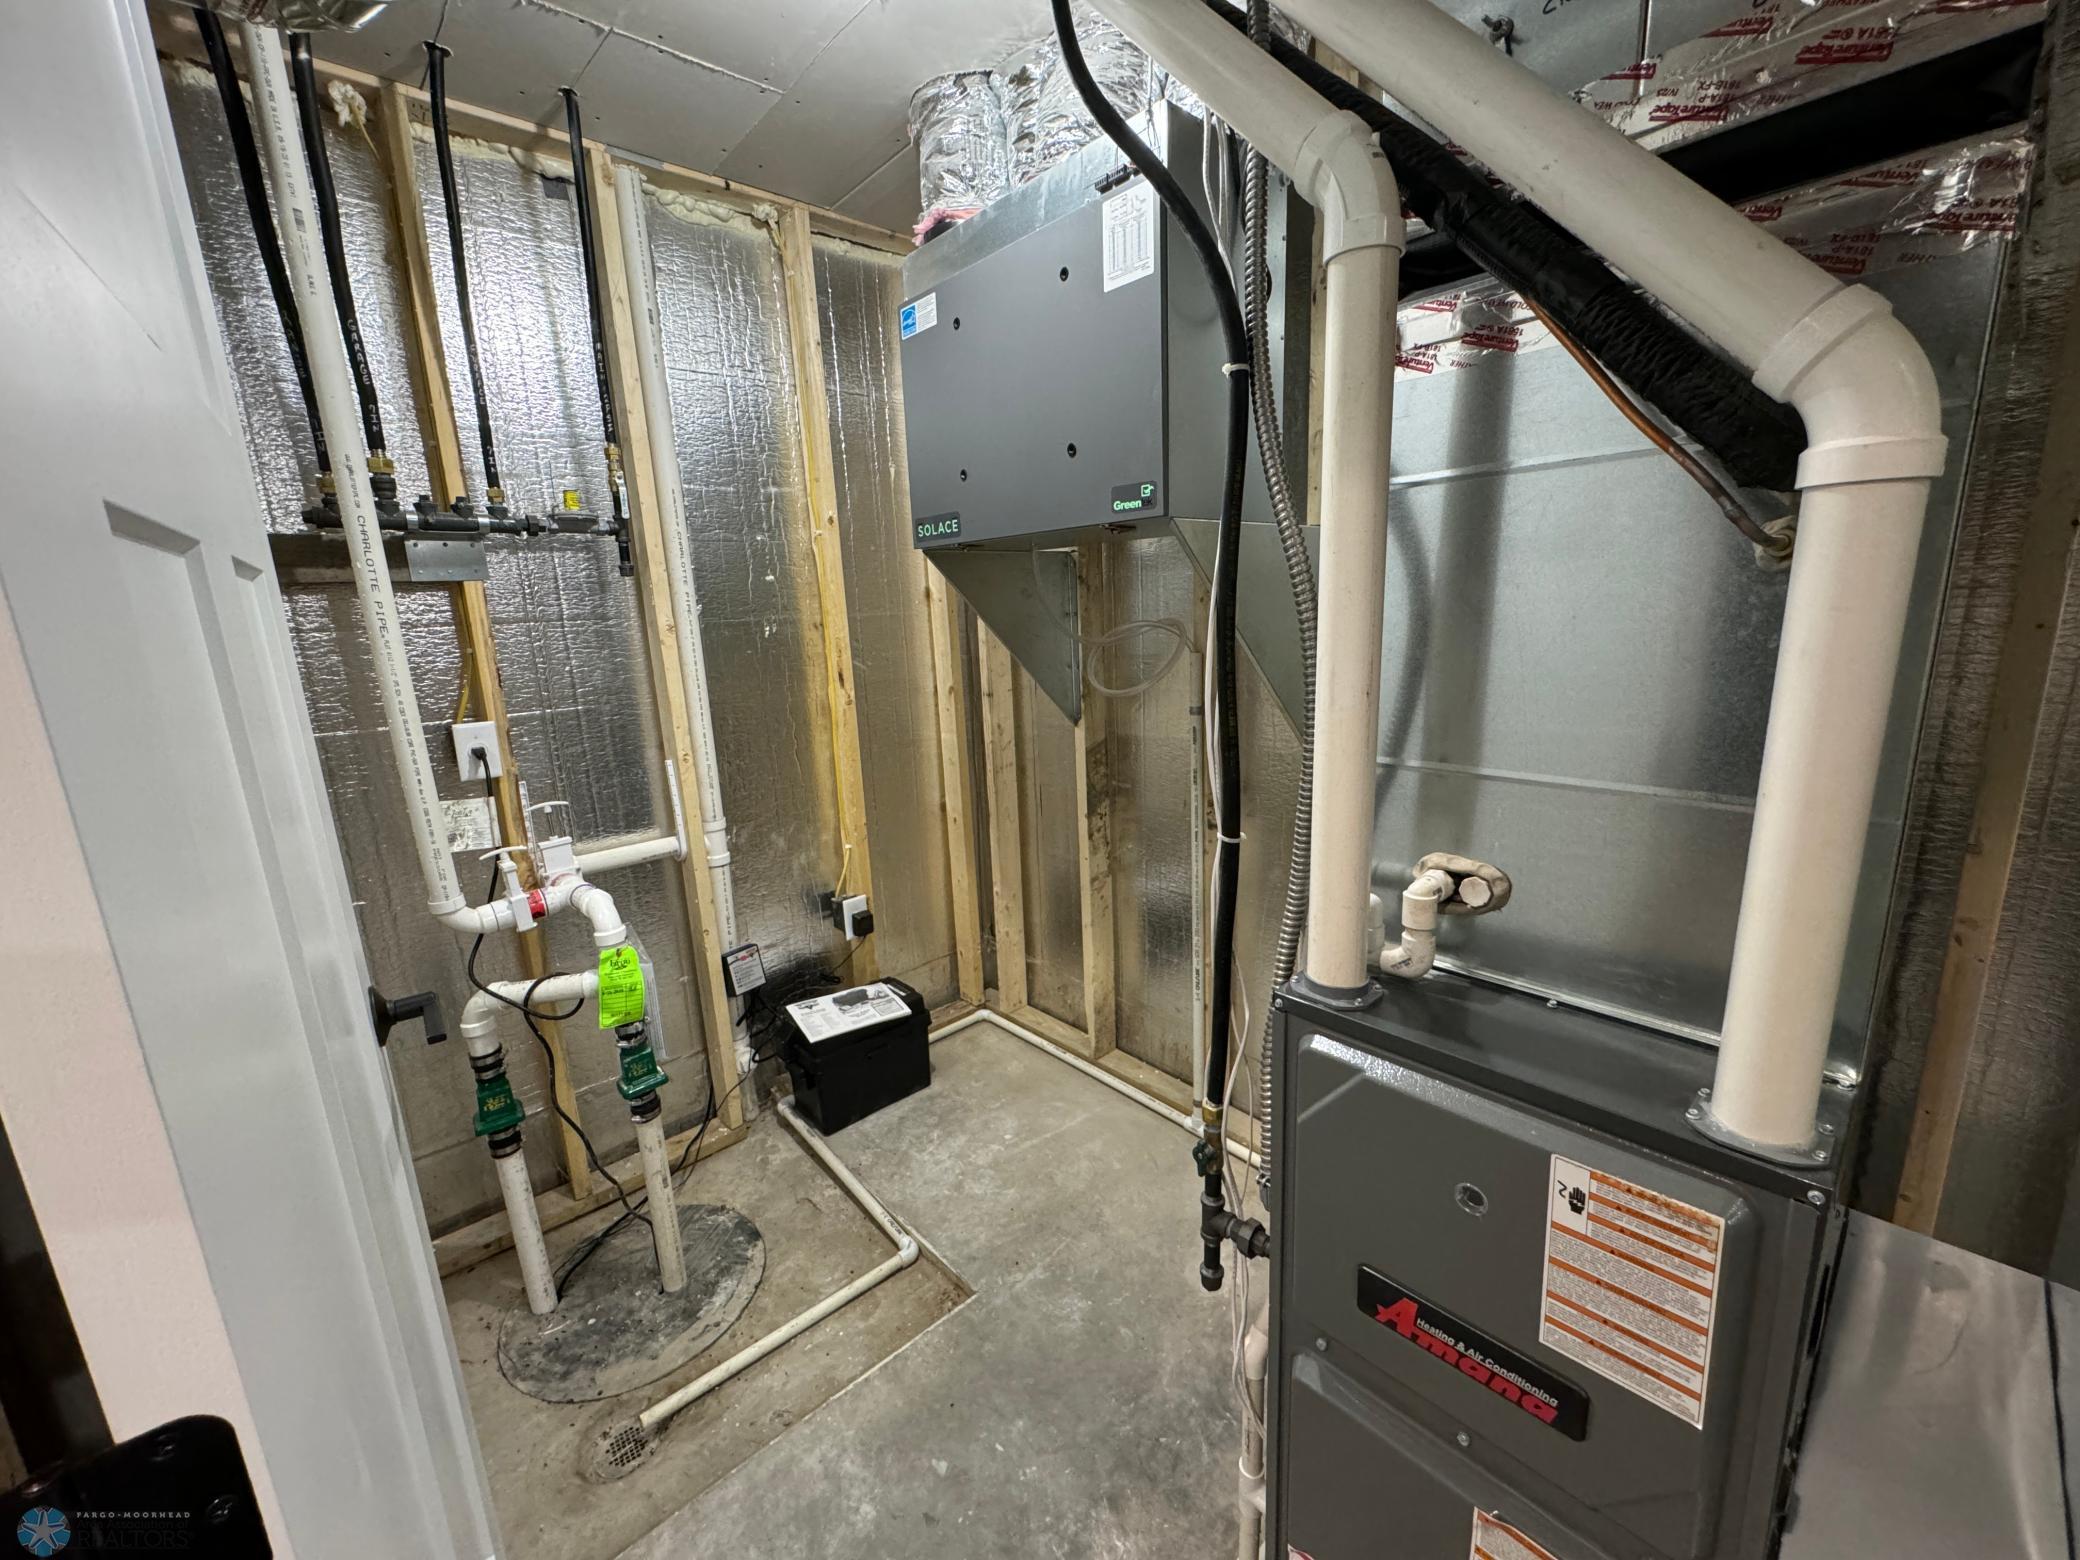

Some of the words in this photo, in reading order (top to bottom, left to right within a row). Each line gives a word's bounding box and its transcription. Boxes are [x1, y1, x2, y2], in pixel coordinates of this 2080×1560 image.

[347, 319, 371, 385] GARAGE
[917, 519, 959, 538] SOLACE
[355, 514, 380, 593] CHARLOTTE
[372, 599, 389, 635] PIPE
[1375, 1297, 1559, 1424] Amana
[1416, 1317, 1456, 1347] Heating
[1454, 1341, 1466, 1352] &
[1466, 1348, 1484, 1363] Air
[1485, 1358, 1559, 1408] Conditioning
